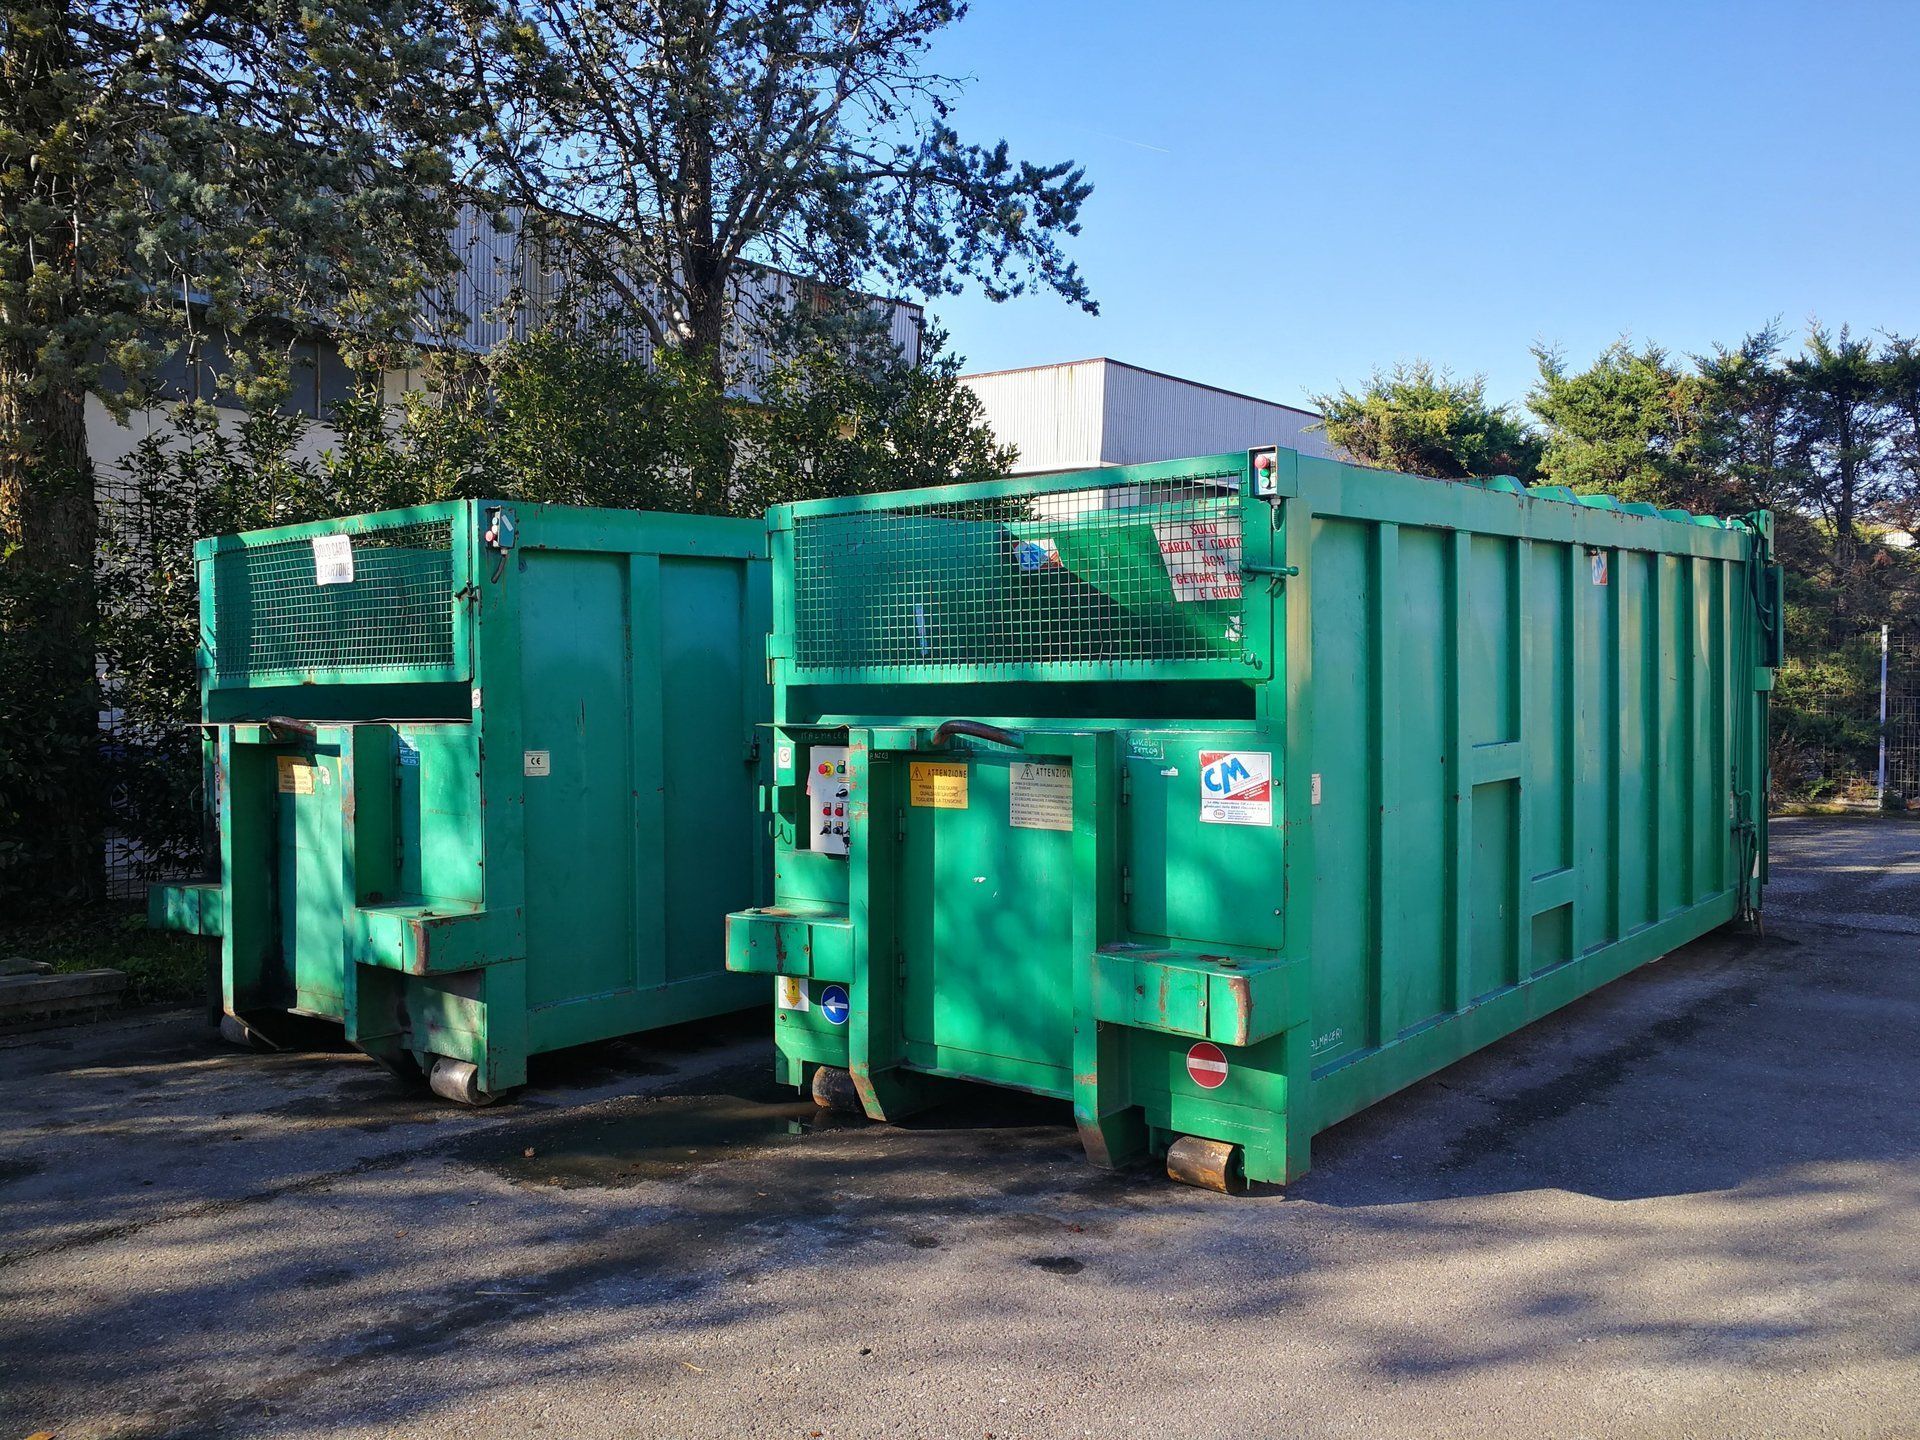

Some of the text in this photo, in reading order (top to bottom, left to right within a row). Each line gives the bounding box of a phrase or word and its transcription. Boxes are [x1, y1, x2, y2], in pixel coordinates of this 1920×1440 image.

[1160, 541, 1193, 553] CARTA
[1197, 540, 1204, 550] E
[1202, 555, 1226, 567] NON
[1175, 572, 1219, 584] GETTARE
[1199, 587, 1205, 599] E
[927, 768, 967, 778] ATTENZIONE
[1204, 757, 1251, 795] CM
